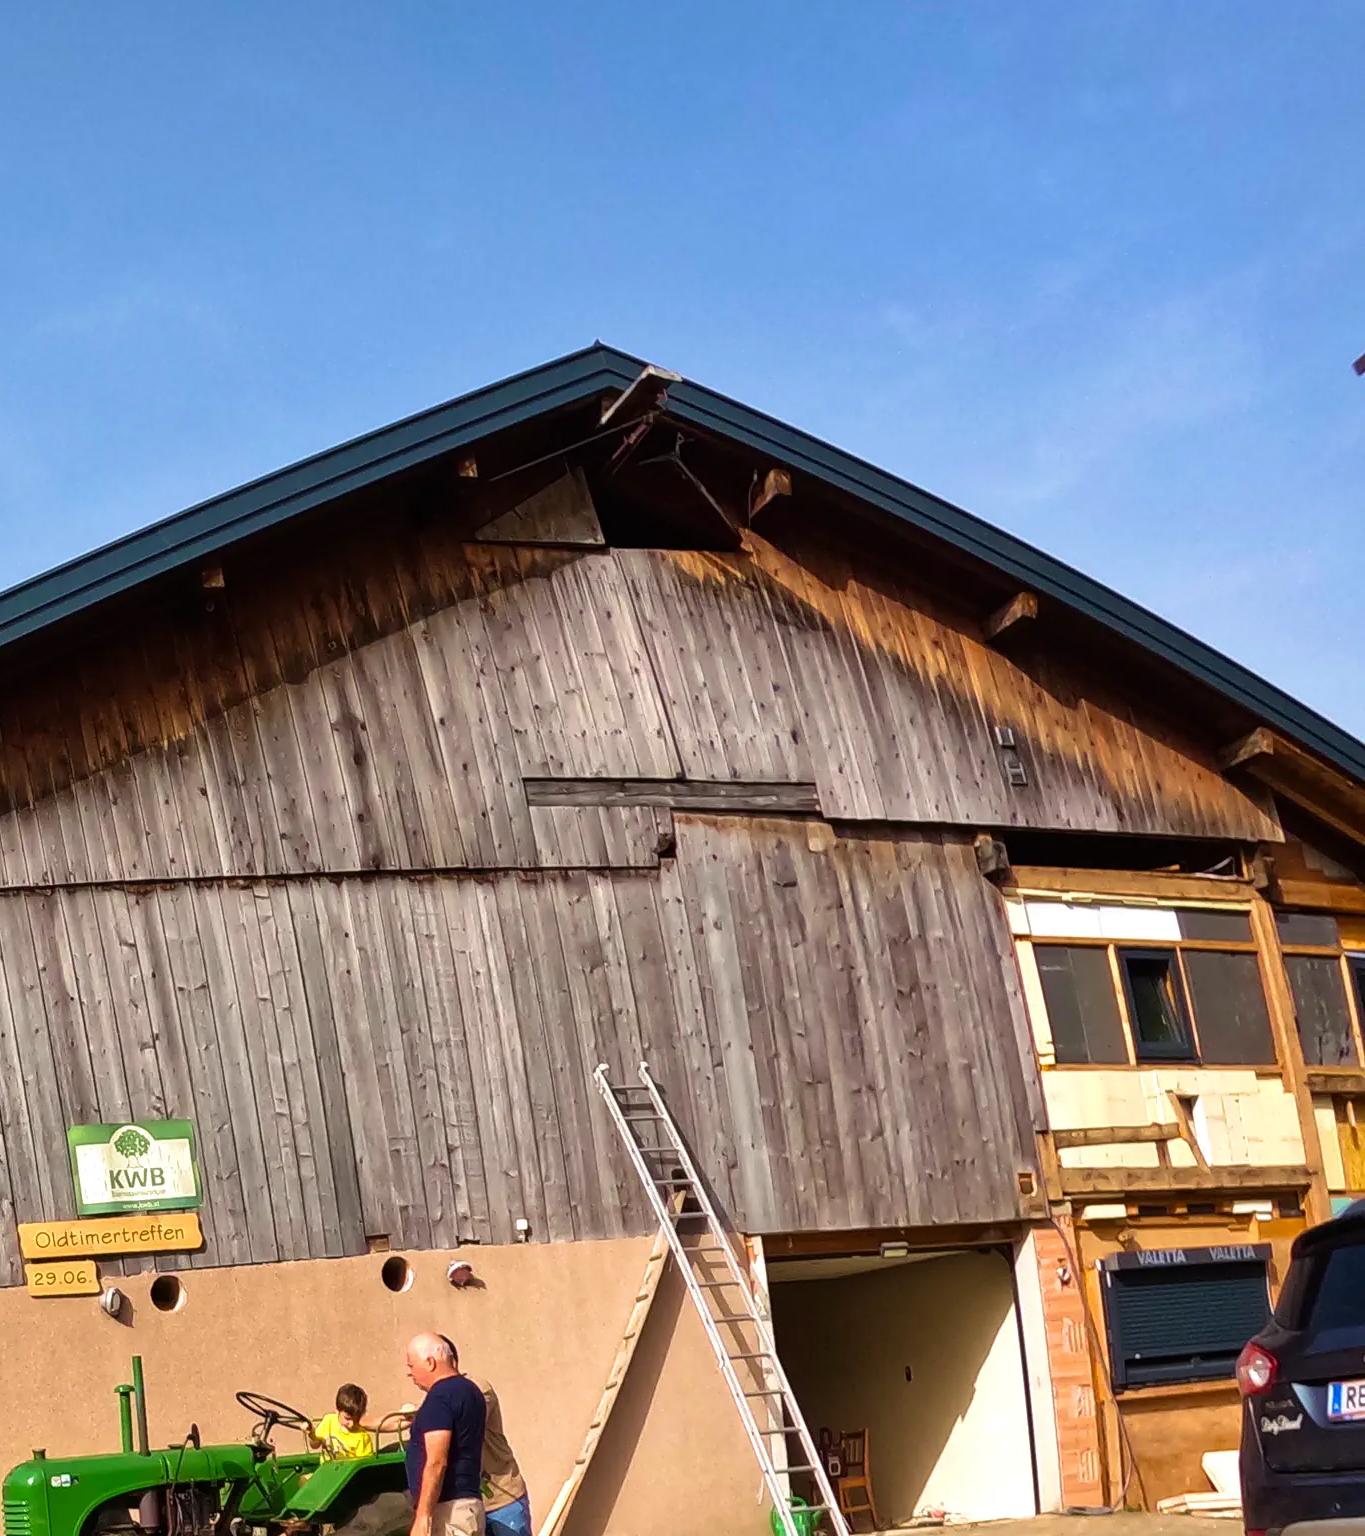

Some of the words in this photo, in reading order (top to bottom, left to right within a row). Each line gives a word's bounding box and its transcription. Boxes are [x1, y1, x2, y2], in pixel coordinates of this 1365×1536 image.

[108, 1167, 166, 1190] KWB
[35, 1225, 185, 1249] Oldtimertreffen
[1136, 1250, 1187, 1266] VALETTA
[1209, 1244, 1257, 1260] VALETTA
[33, 1270, 93, 1286] 29.06.
